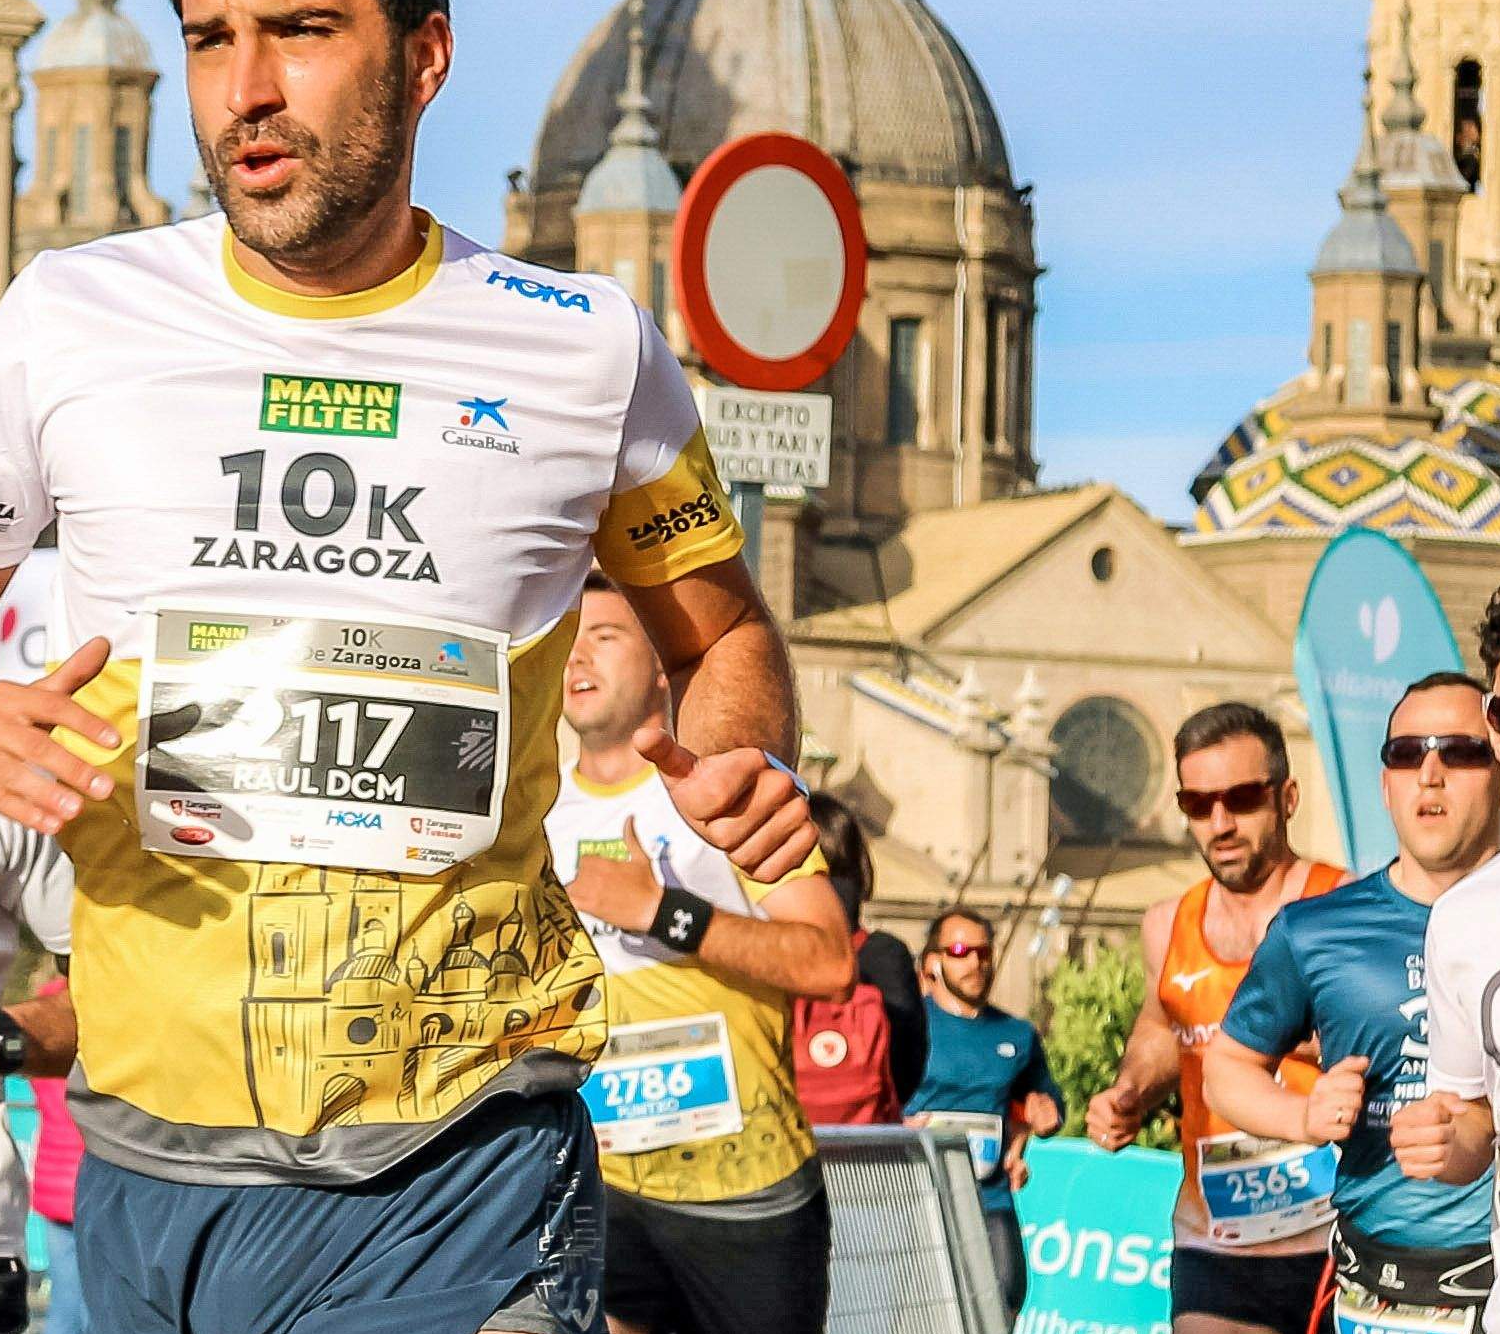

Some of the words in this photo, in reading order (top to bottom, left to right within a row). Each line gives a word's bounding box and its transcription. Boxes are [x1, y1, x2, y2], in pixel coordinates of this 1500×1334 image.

[486, 270, 593, 313] HOKA
[270, 378, 394, 409] MANN
[266, 403, 393, 433] FILTER
[720, 400, 810, 428] EXCEPTO
[442, 430, 520, 455] CaixaBank
[219, 449, 426, 544] 10K
[657, 506, 721, 544] 2023
[191, 536, 442, 585] ZARAGOZA
[192, 625, 247, 641] MANN
[340, 627, 384, 650] 10K
[331, 647, 422, 671] Zaragoza
[326, 769, 407, 803] DCM
[325, 810, 383, 830] HOKA
[600, 1061, 694, 1108] 2786
[1226, 1157, 1310, 1203] 2565
